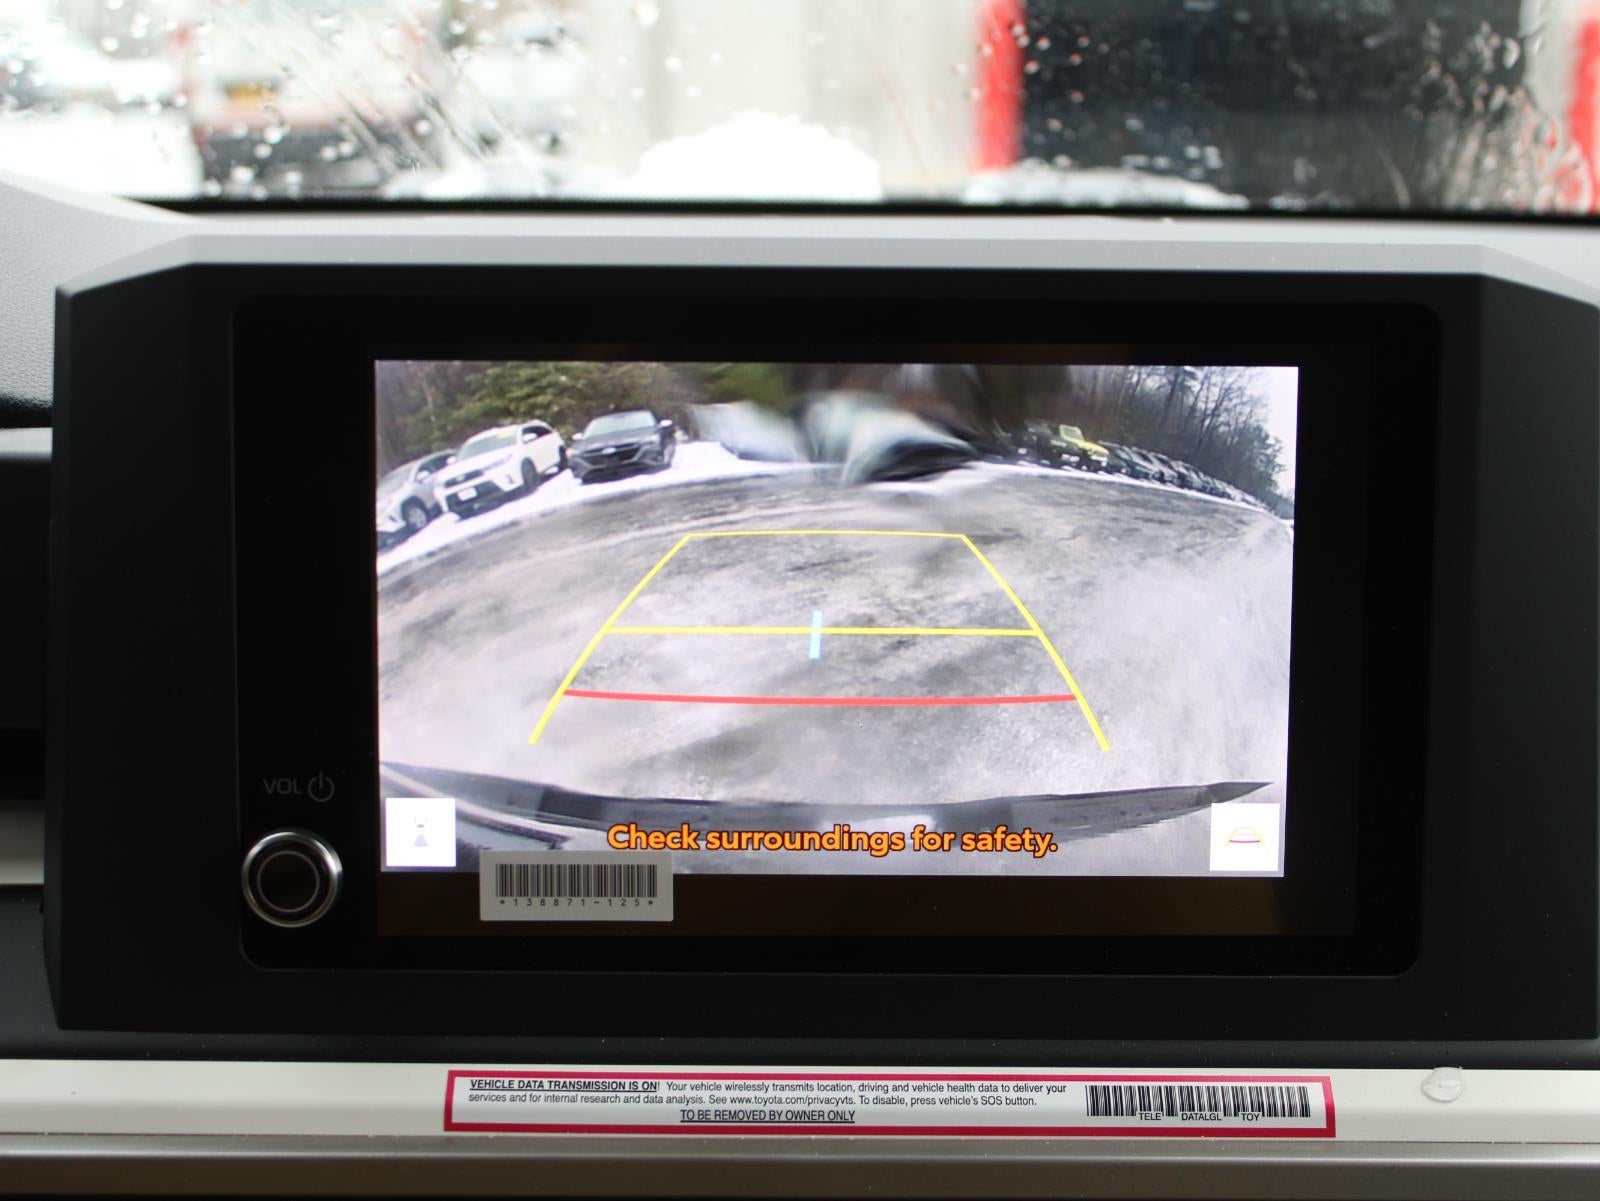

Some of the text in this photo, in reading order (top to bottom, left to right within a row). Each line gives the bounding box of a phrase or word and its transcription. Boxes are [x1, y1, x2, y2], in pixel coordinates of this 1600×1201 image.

[262, 777, 304, 794] VOL
[607, 822, 1058, 858] Check surroundings for safety.
[470, 1079, 515, 1090] VEHICLE
[517, 1079, 545, 1090] DATA
[547, 1080, 628, 1091] TRANSMISSION
[628, 1080, 639, 1091] IS
[666, 1081, 687, 1092] Your
[689, 1081, 722, 1092] vehicle
[724, 1081, 770, 1094] wirelessly
[772, 1082, 815, 1092] transmits
[816, 1082, 856, 1094] location,
[857, 1083, 889, 1094] driving
[891, 1083, 910, 1093] and
[911, 1083, 945, 1093] vehicle
[946, 1083, 976, 1093] health
[977, 1083, 999, 1093] data
[1000, 1083, 1011, 1093] to
[1012, 1083, 1044, 1093] deliver
[1045, 1084, 1067, 1095] your
[468, 1093, 1037, 1107] services and for internal research and data analysis. See www.toyota.com/privacyvts. To disable, press vehicle's SOS button.
[680, 1109, 856, 1121] TO BE REMOVED BY OWNER ONLY
[1138, 1112, 1260, 1122] TELE DATALGL TOY
